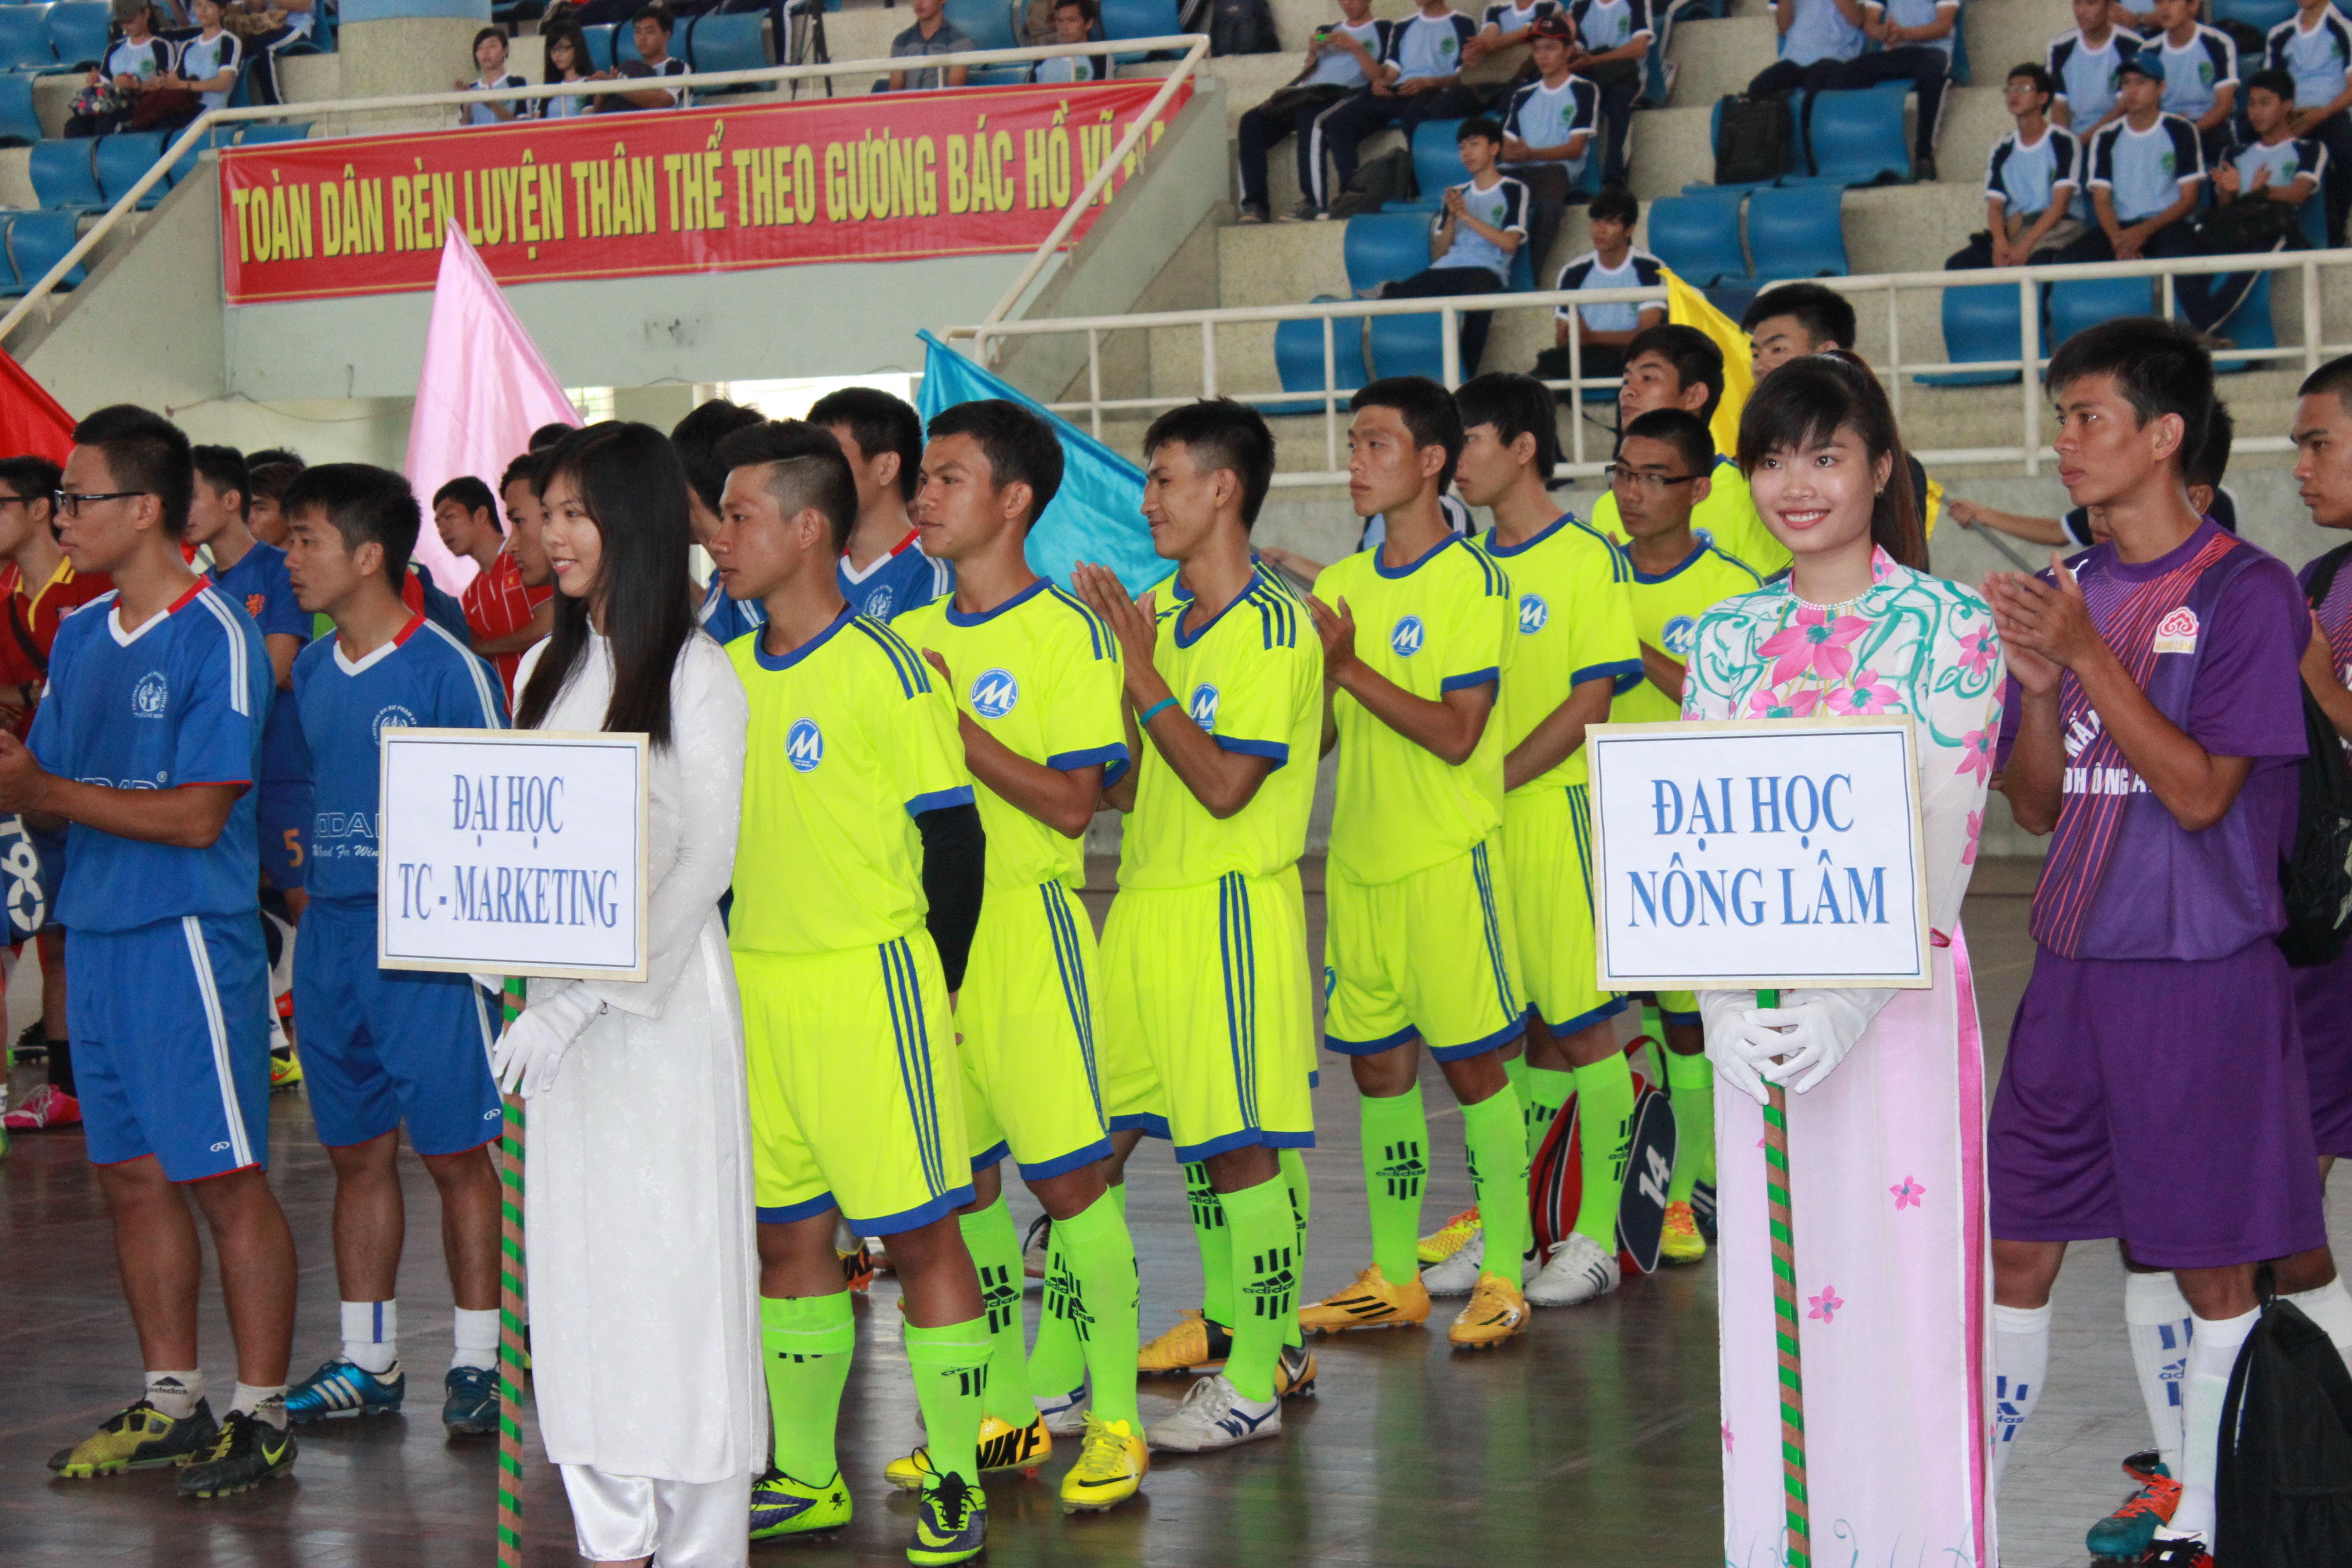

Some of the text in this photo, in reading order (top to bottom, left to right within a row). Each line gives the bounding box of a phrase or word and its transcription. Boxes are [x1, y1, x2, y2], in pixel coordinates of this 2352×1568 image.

[232, 169, 313, 262] TOÀN
[321, 164, 385, 257] DÂN
[392, 157, 454, 252] RÈN
[464, 149, 565, 259] LUYỆN
[571, 142, 657, 238] THÂN
[664, 119, 725, 232] THỂ
[732, 144, 816, 228] THEO
[825, 128, 938, 223] GƯƠNG
[947, 115, 1014, 215] BÁC
[1025, 100, 1071, 211] HỒ
[1392, 624, 1421, 648] M
[972, 679, 1013, 709] M
[787, 729, 821, 761] M
[453, 774, 564, 850] ĐẠI HỌC
[1651, 774, 1854, 852] ĐẠI HỌC
[283, 829, 303, 867] 5
[398, 863, 618, 928] TC - MARKETING
[1627, 848, 1890, 928] NÔNG LÂM
[1376, 1168, 1426, 1176] adidas
[1639, 1144, 1670, 1209] 14
